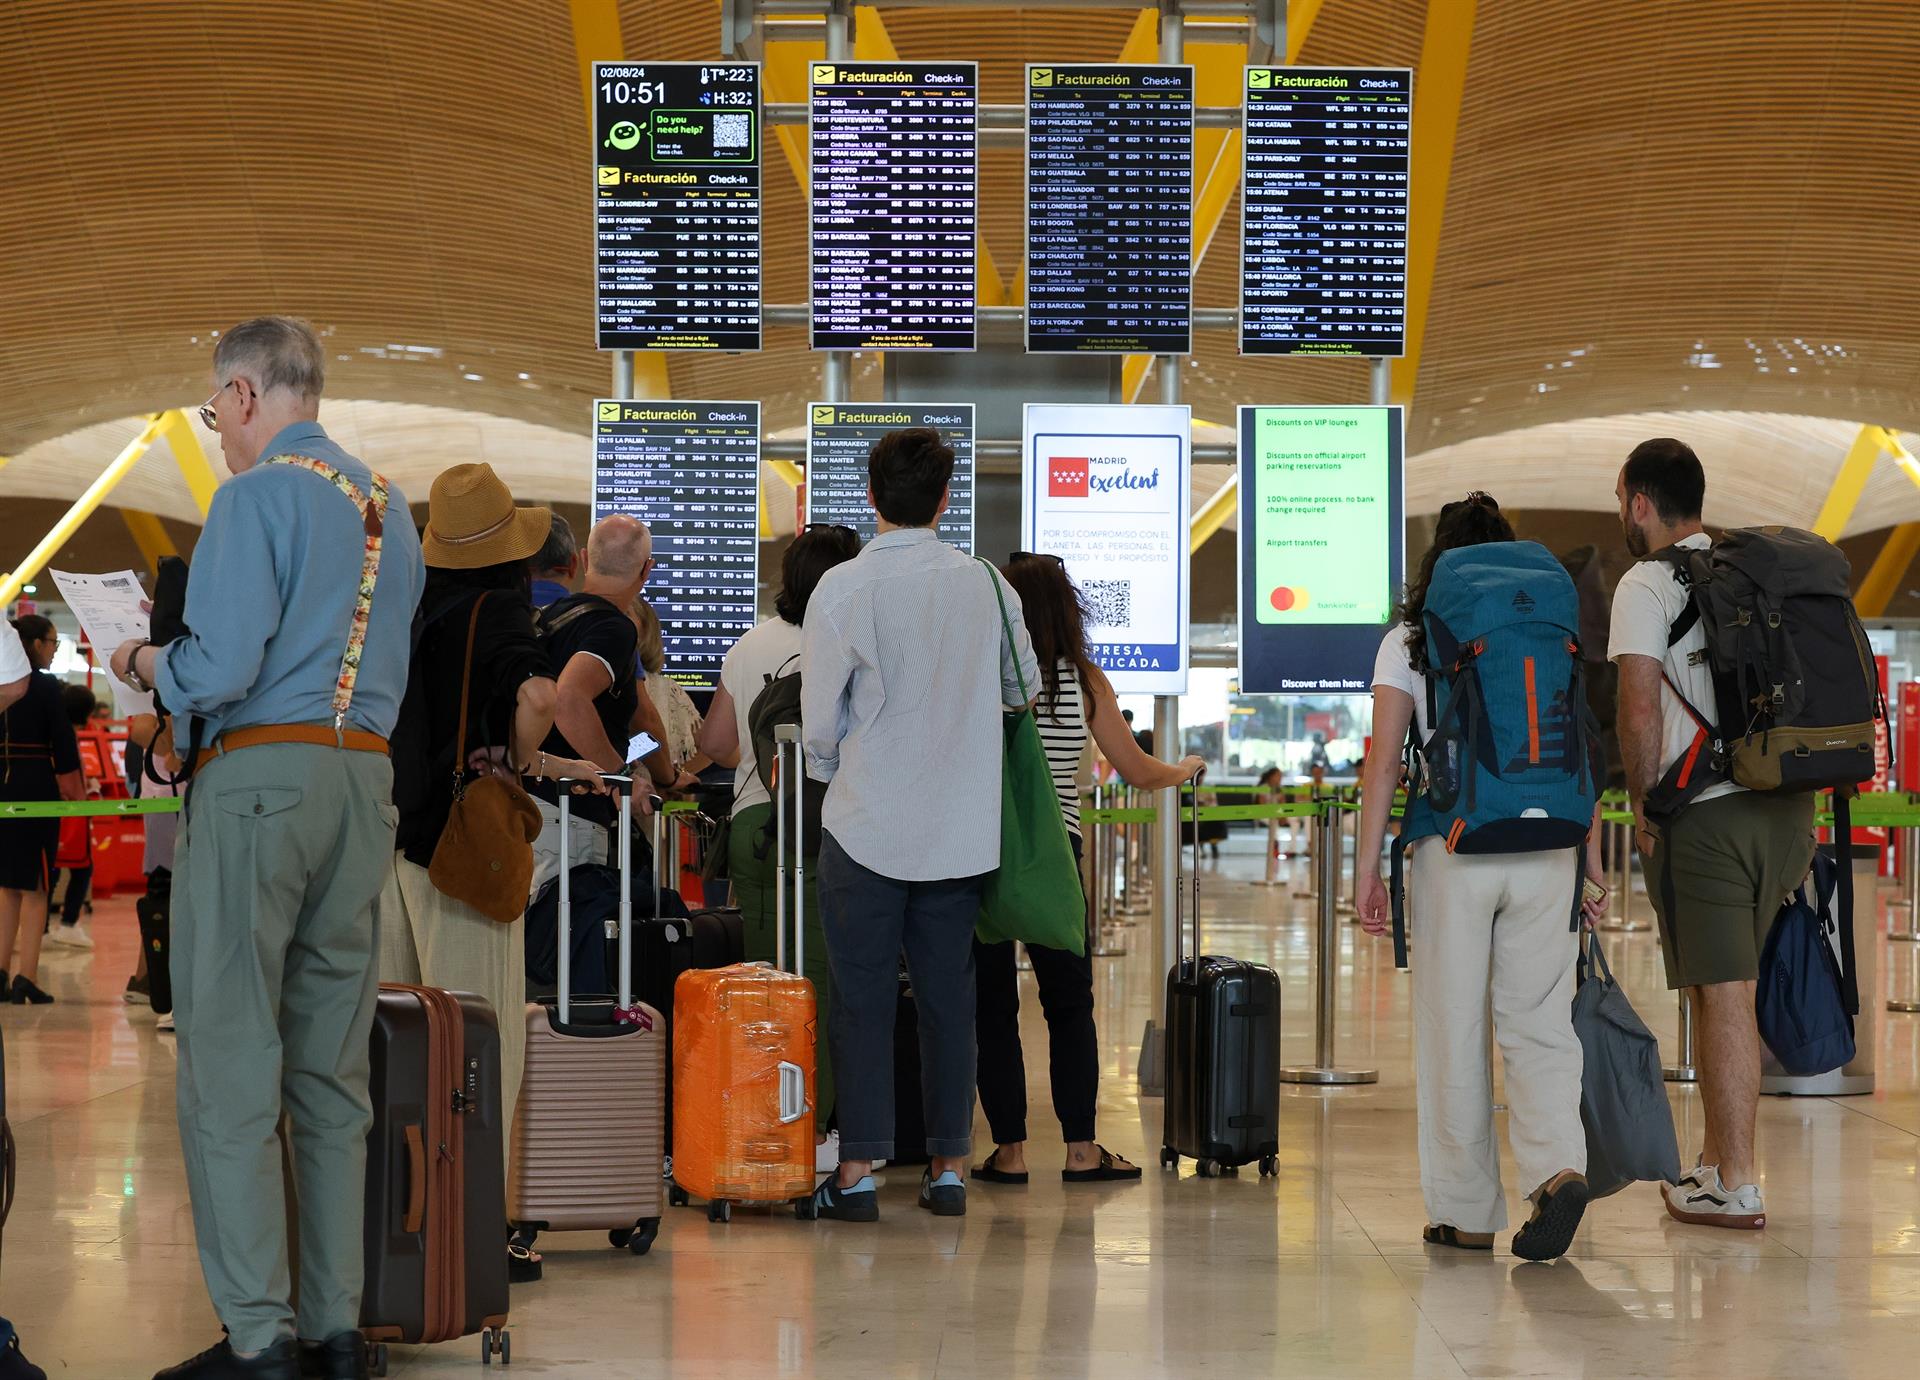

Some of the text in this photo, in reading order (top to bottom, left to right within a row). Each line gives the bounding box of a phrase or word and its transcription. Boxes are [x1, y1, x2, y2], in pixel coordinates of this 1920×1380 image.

[600, 68, 645, 78] 02/08/24
[839, 71, 964, 83] Facturación Check-in
[1057, 74, 1181, 86] Facturación Check-in
[1275, 75, 1399, 88] Facturación Check-in
[601, 82, 665, 104] 10:51
[657, 116, 668, 124] Do
[681, 126, 703, 135] help?
[624, 172, 748, 184] Facturación Check-in
[624, 409, 747, 421] Facturación Check-in
[839, 412, 962, 424] Facturación Check-in
[1329, 419, 1358, 427] lounges
[1089, 457, 1127, 465] MADRID
[1341, 453, 1366, 461] airport
[1266, 463, 1294, 471] parking
[1043, 530, 1061, 538] POR
[1076, 531, 1138, 539] COMPROMISO
[1139, 531, 1159, 539] CON
[1161, 531, 1169, 539] EL
[1267, 540, 1292, 548] Airport
[1093, 646, 1143, 656] PRESA
[1281, 680, 1364, 688] Discover them here:
